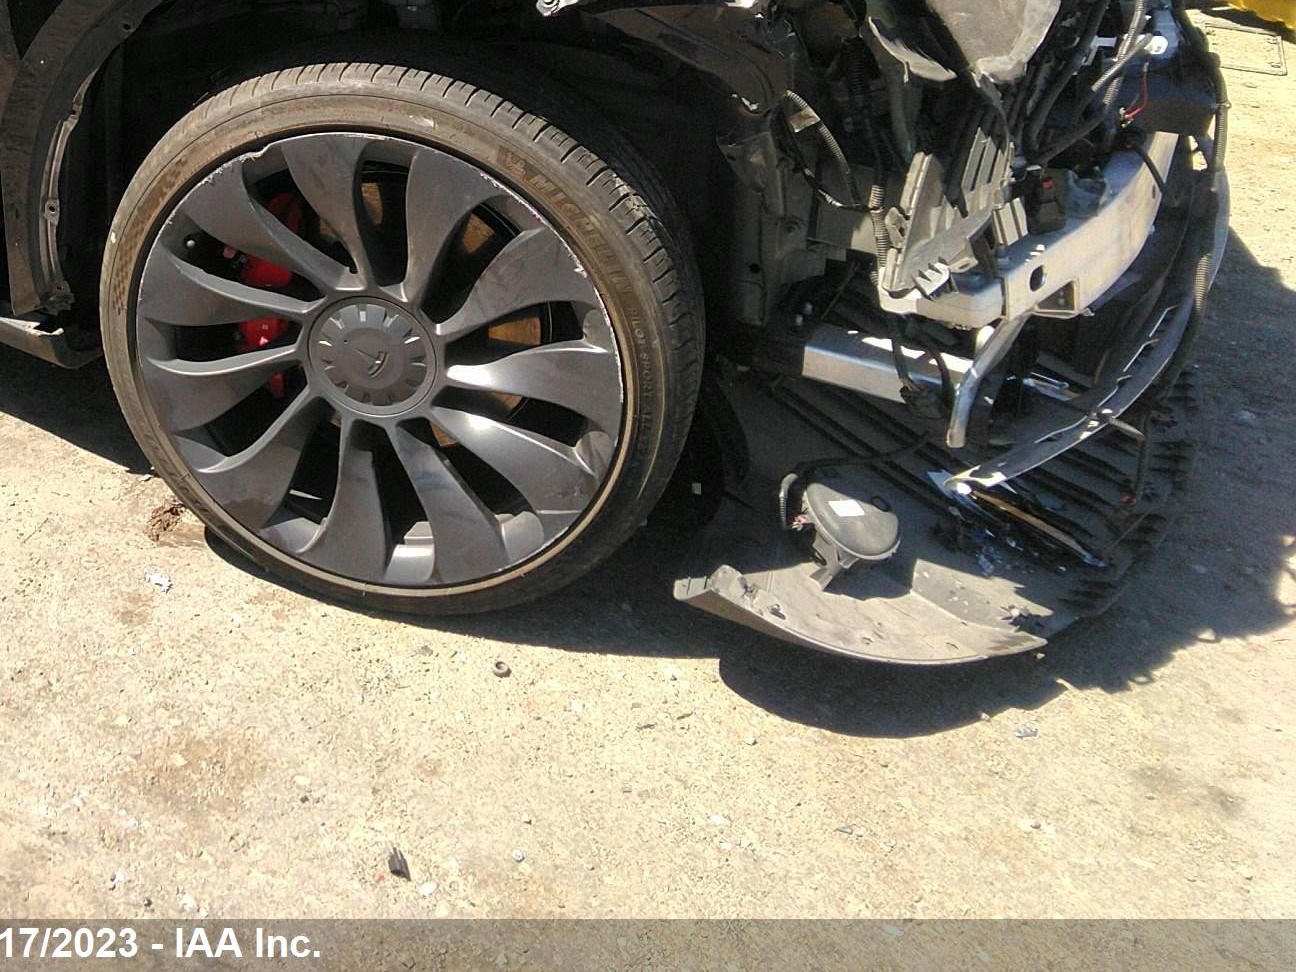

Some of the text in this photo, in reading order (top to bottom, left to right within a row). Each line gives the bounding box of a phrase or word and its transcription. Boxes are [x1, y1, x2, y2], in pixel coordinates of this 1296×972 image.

[527, 171, 635, 295] MICHELIN
[628, 307, 646, 346] PILOT
[639, 352, 654, 398] SPORT
